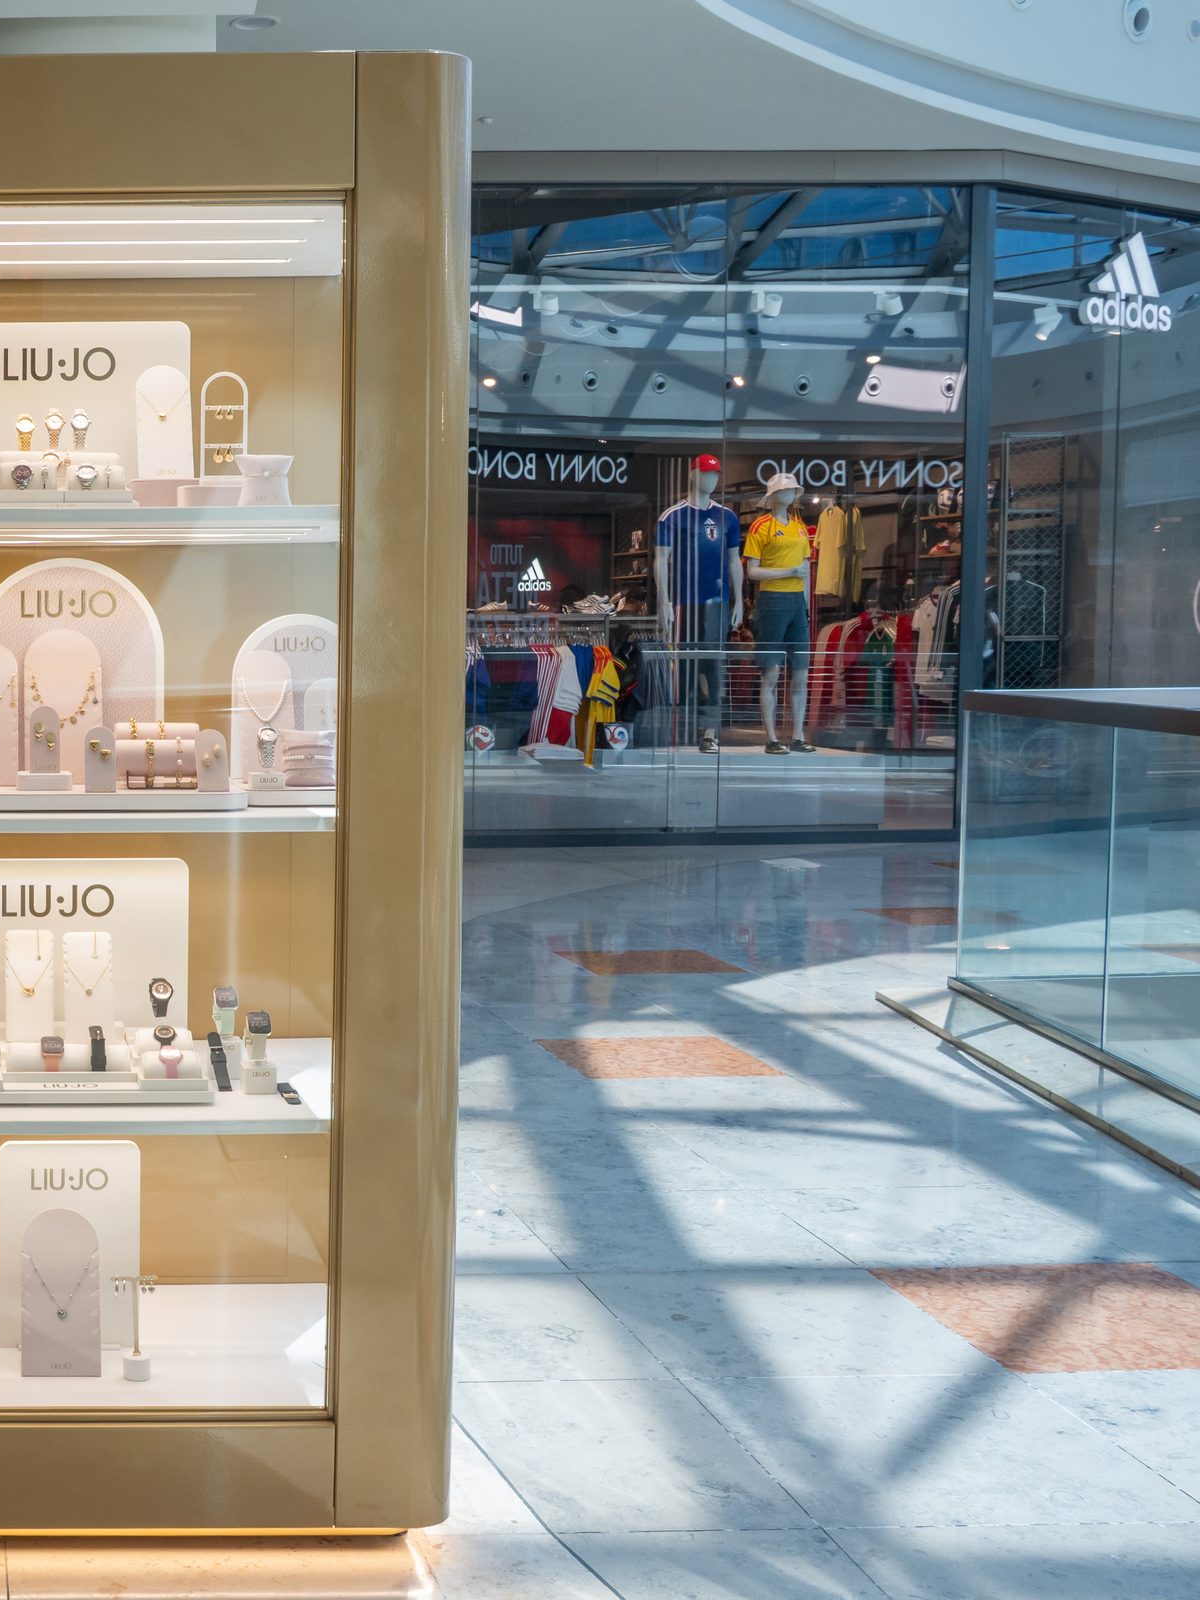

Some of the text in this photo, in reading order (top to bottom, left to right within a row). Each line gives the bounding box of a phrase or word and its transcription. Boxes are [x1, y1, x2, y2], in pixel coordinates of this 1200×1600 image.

[1086, 291, 1172, 332] adidas
[2, 346, 117, 382] LIU·JO
[517, 578, 552, 593] adidas
[20, 589, 117, 619] LIU·JO
[1, 883, 115, 918] LIU·JO
[30, 1167, 109, 1191] LIU·JO
